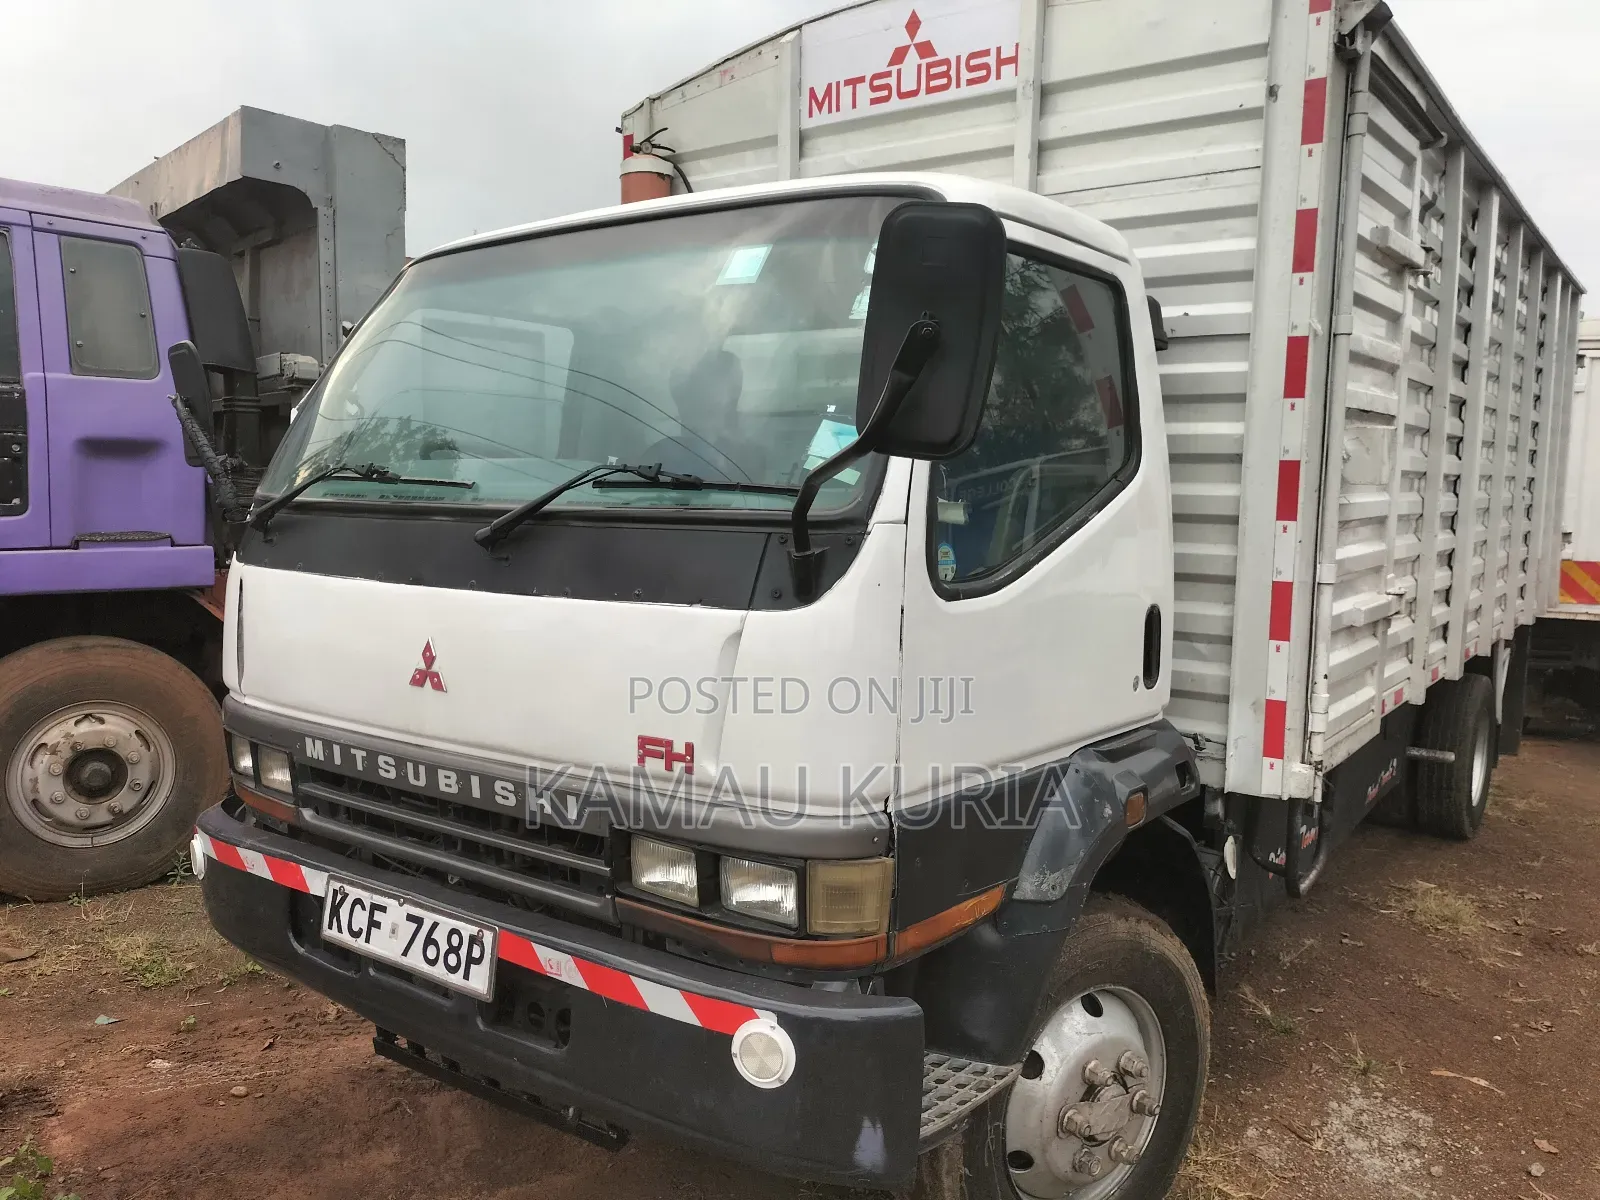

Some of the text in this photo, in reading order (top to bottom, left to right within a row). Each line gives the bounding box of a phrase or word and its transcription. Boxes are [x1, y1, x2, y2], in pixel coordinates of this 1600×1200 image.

[808, 42, 1020, 118] MITSUBISH
[304, 736, 578, 820] MITSUBISHI
[637, 734, 694, 775] FH
[327, 888, 485, 982] KCF 768P
